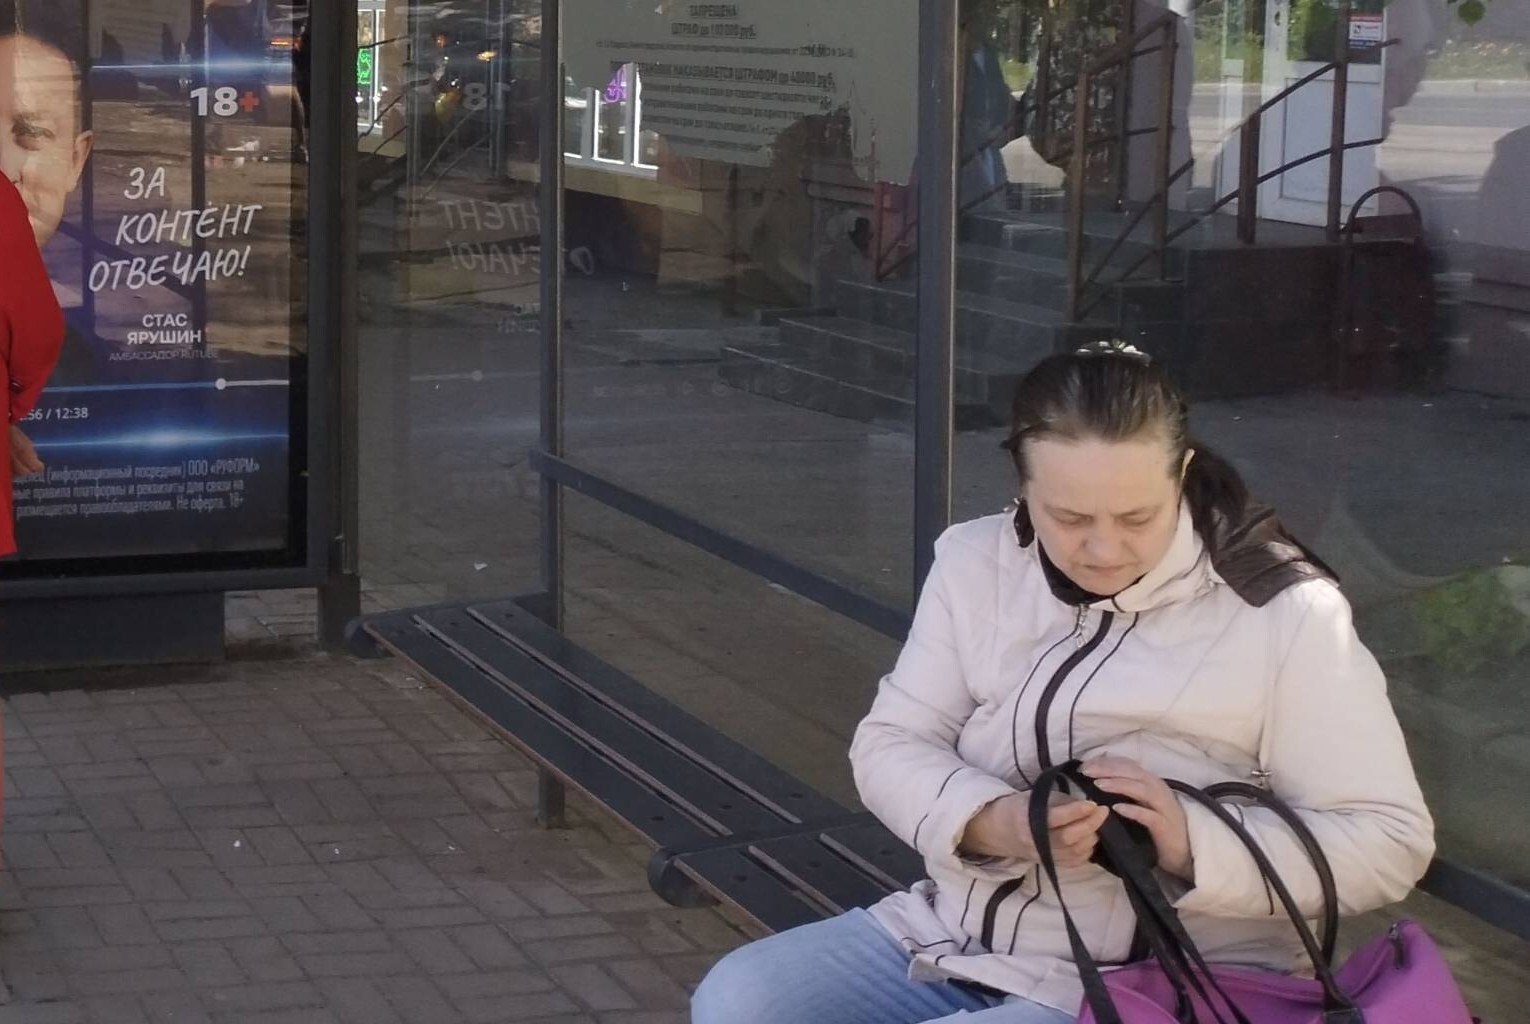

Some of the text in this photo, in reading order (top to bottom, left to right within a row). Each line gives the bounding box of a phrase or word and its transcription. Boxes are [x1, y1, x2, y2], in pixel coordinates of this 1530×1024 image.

[190, 86, 260, 117] 18+
[124, 167, 165, 199] ЗА
[116, 204, 262, 246] КОНТЕНТ
[88, 245, 251, 292] ОТВЕЧАЮ!
[142, 313, 188, 328] СТАС
[127, 329, 202, 346] ЯРУШИН
[55, 407, 88, 420] 12:38
[176, 495, 188, 510] Не
